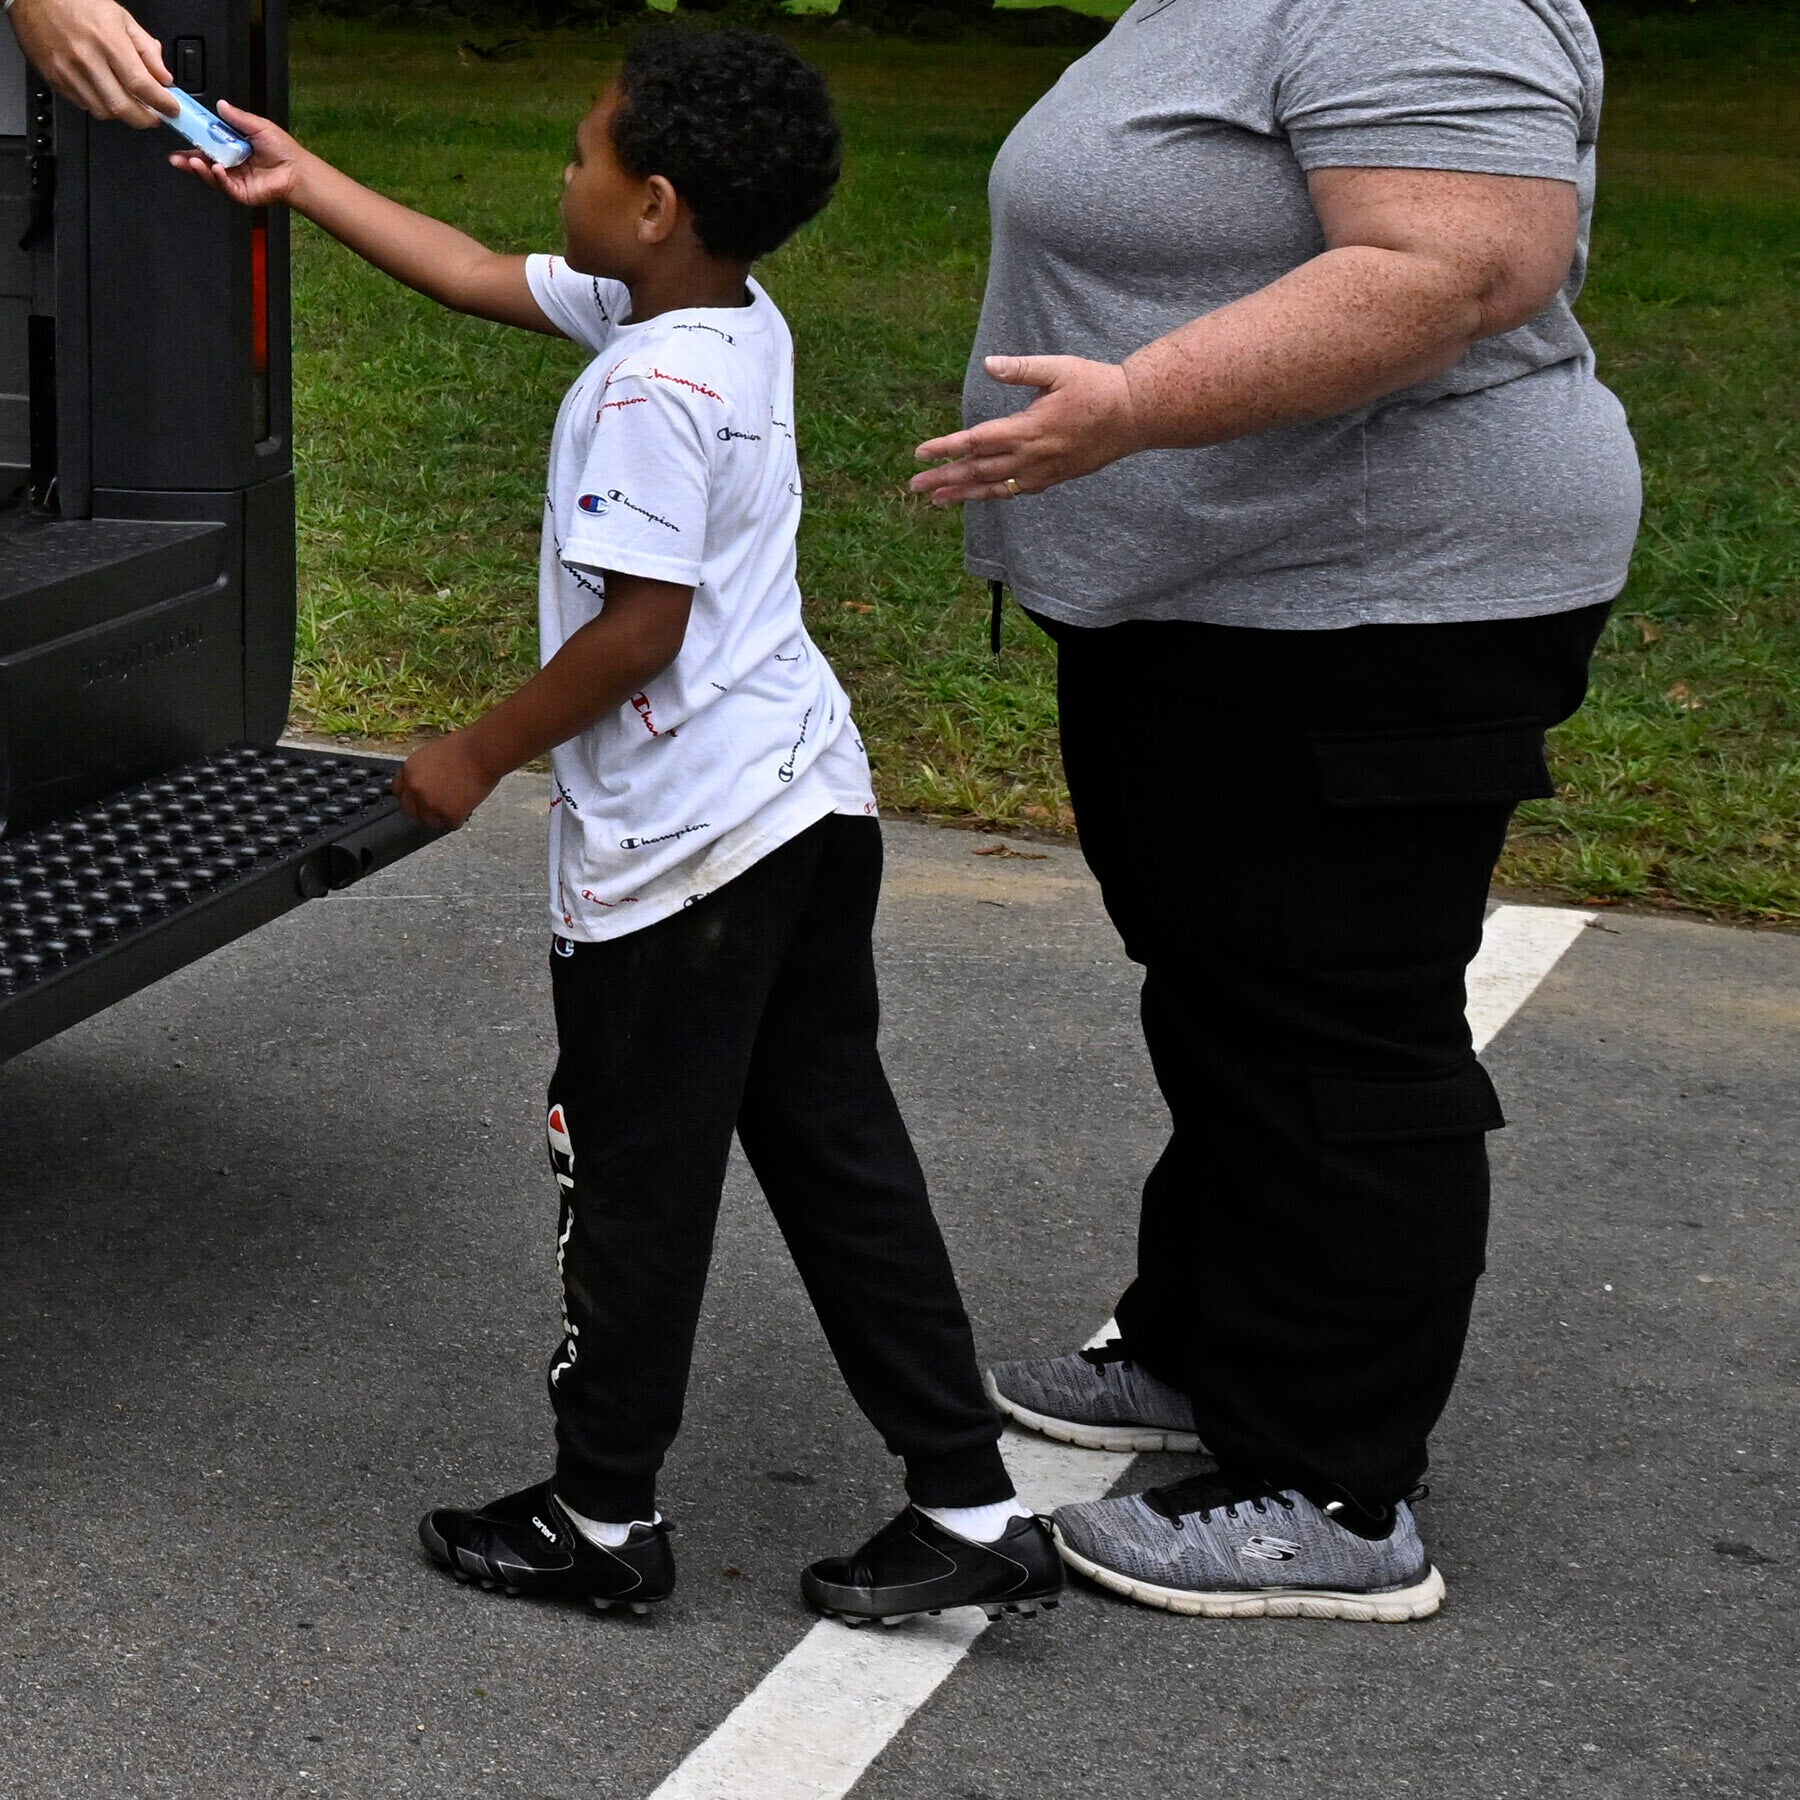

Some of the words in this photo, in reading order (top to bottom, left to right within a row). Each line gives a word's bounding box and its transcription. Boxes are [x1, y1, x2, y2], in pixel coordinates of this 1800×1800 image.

[607, 488, 682, 533] Champion
[777, 705, 813, 784] Champion
[619, 821, 712, 851] Champion
[531, 1515, 558, 1545] carter's
